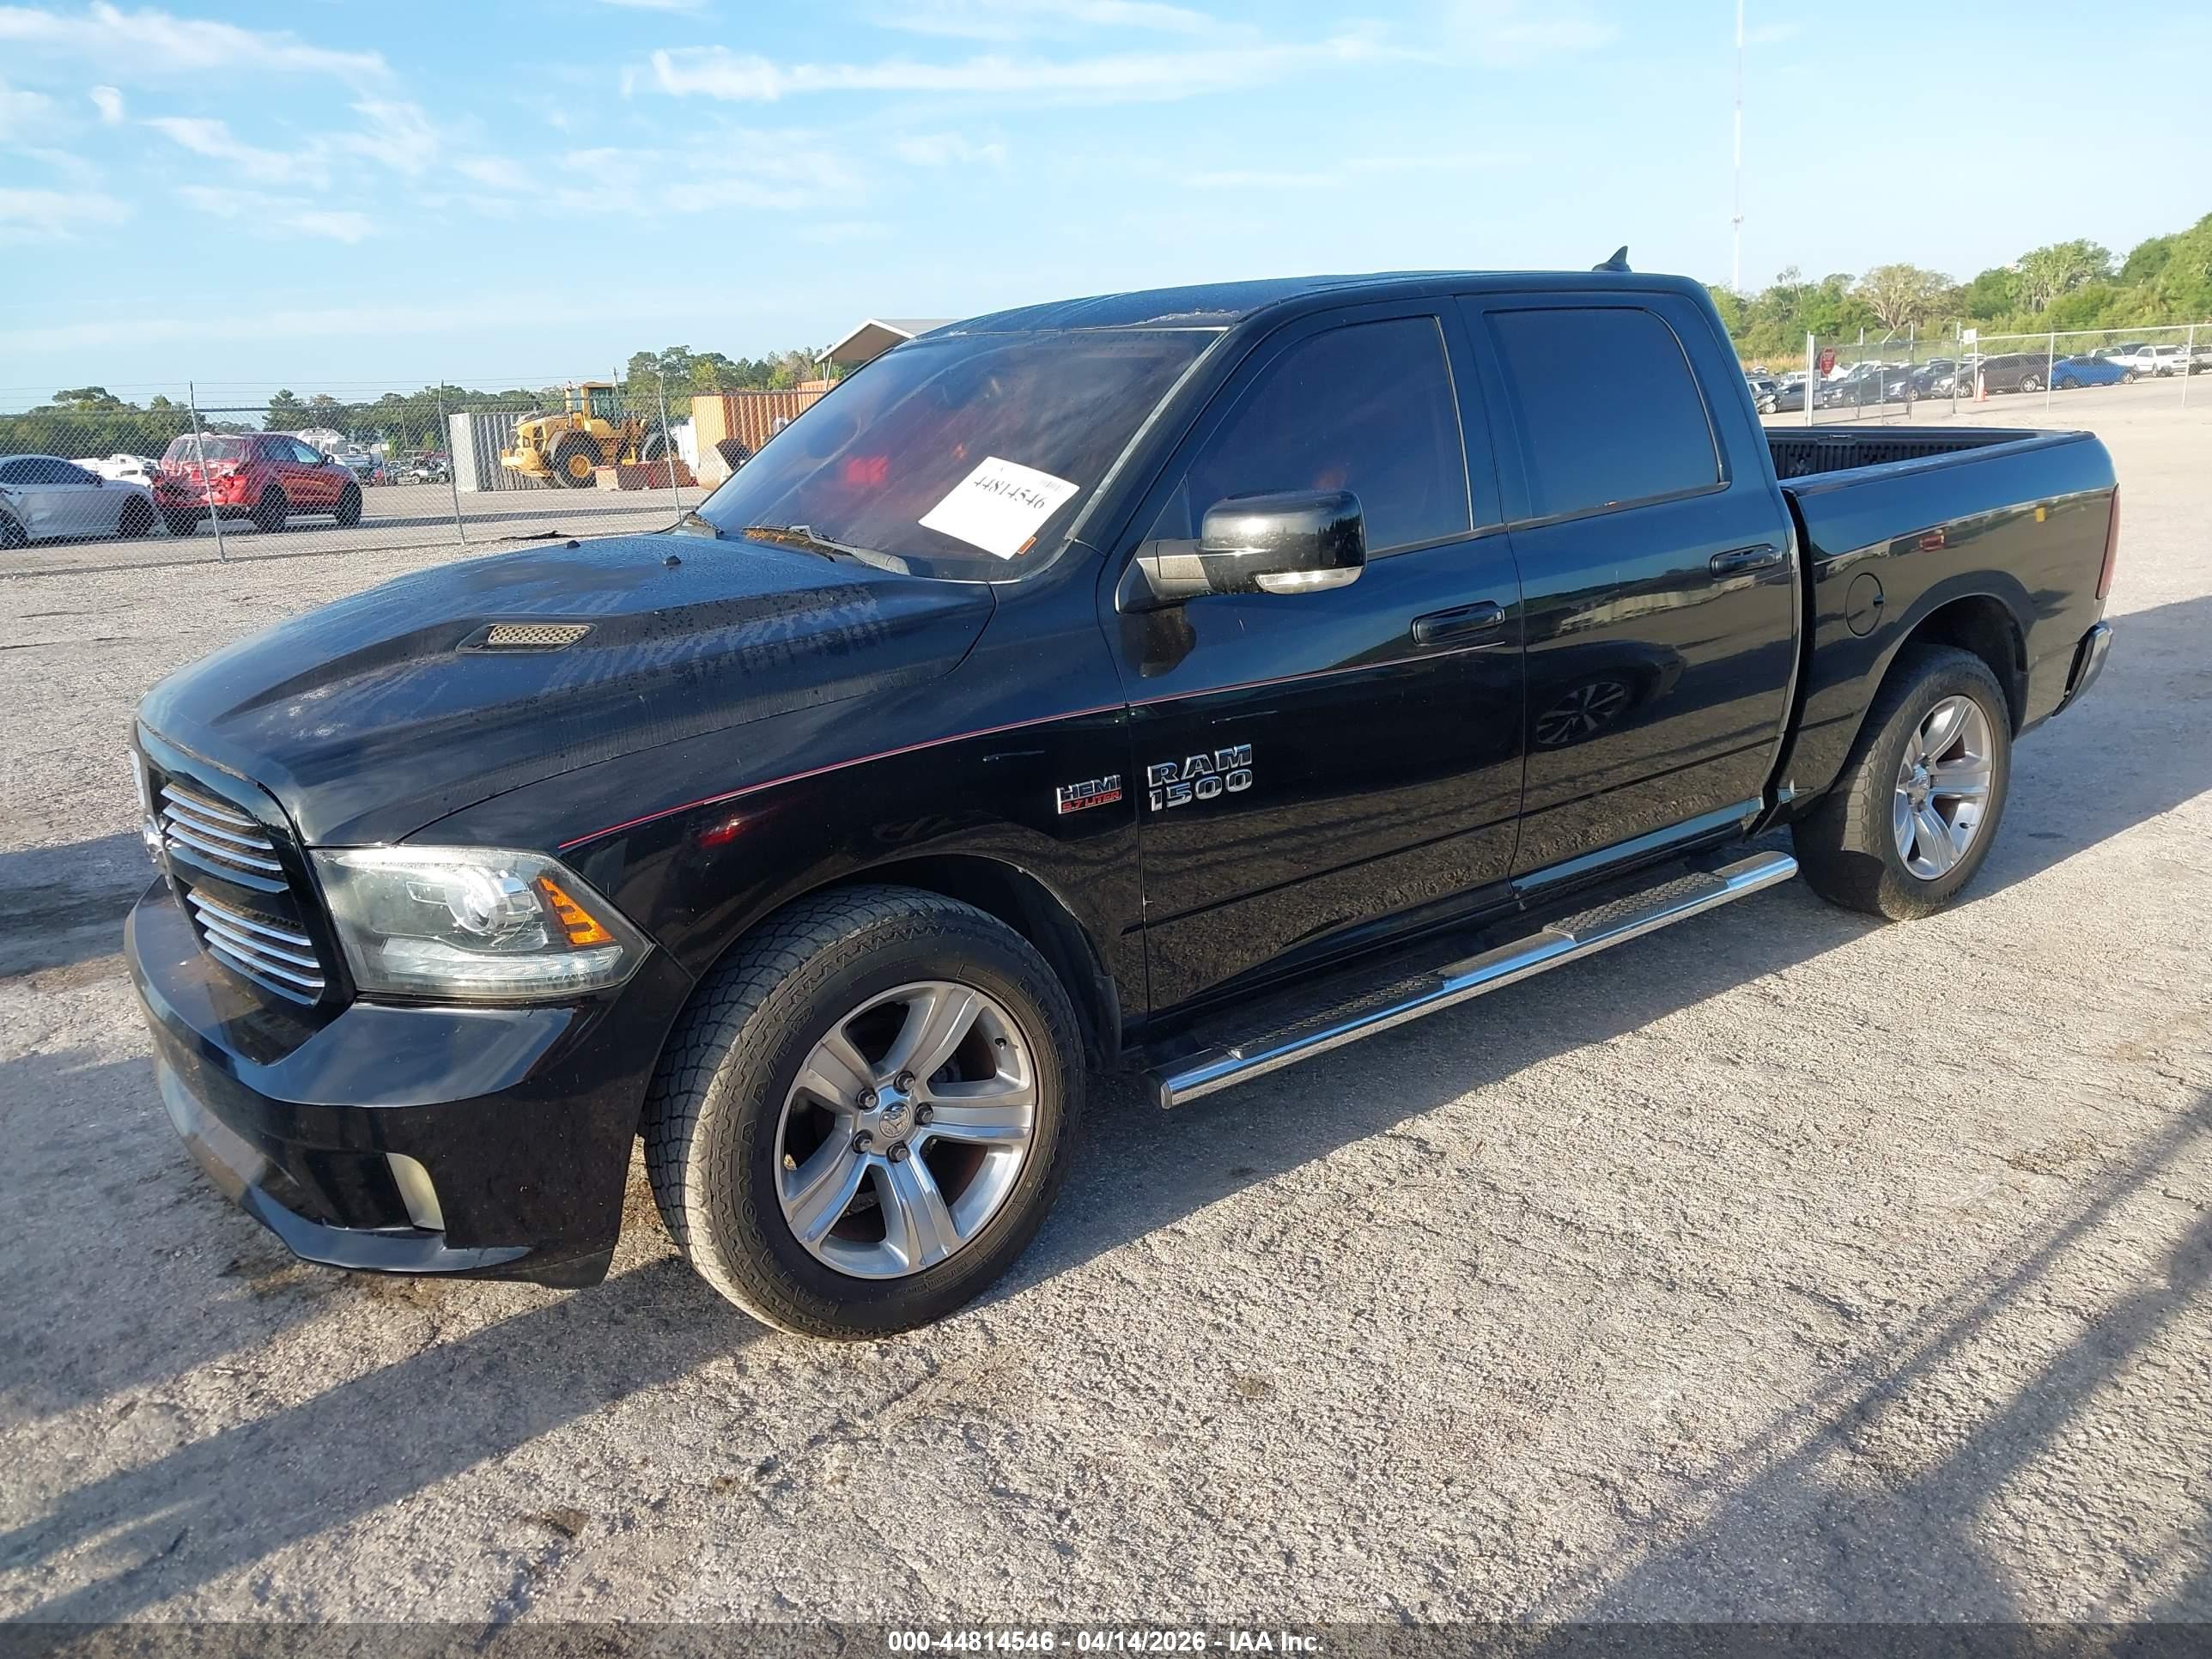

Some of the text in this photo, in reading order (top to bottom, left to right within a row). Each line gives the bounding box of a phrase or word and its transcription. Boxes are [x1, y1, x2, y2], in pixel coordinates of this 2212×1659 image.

[974, 476, 1046, 508] 44814546
[1147, 744, 1252, 787] RAM
[1058, 775, 1121, 801] HEMI
[1062, 791, 1120, 811] 5.7 LITER
[1149, 769, 1253, 811] 1500
